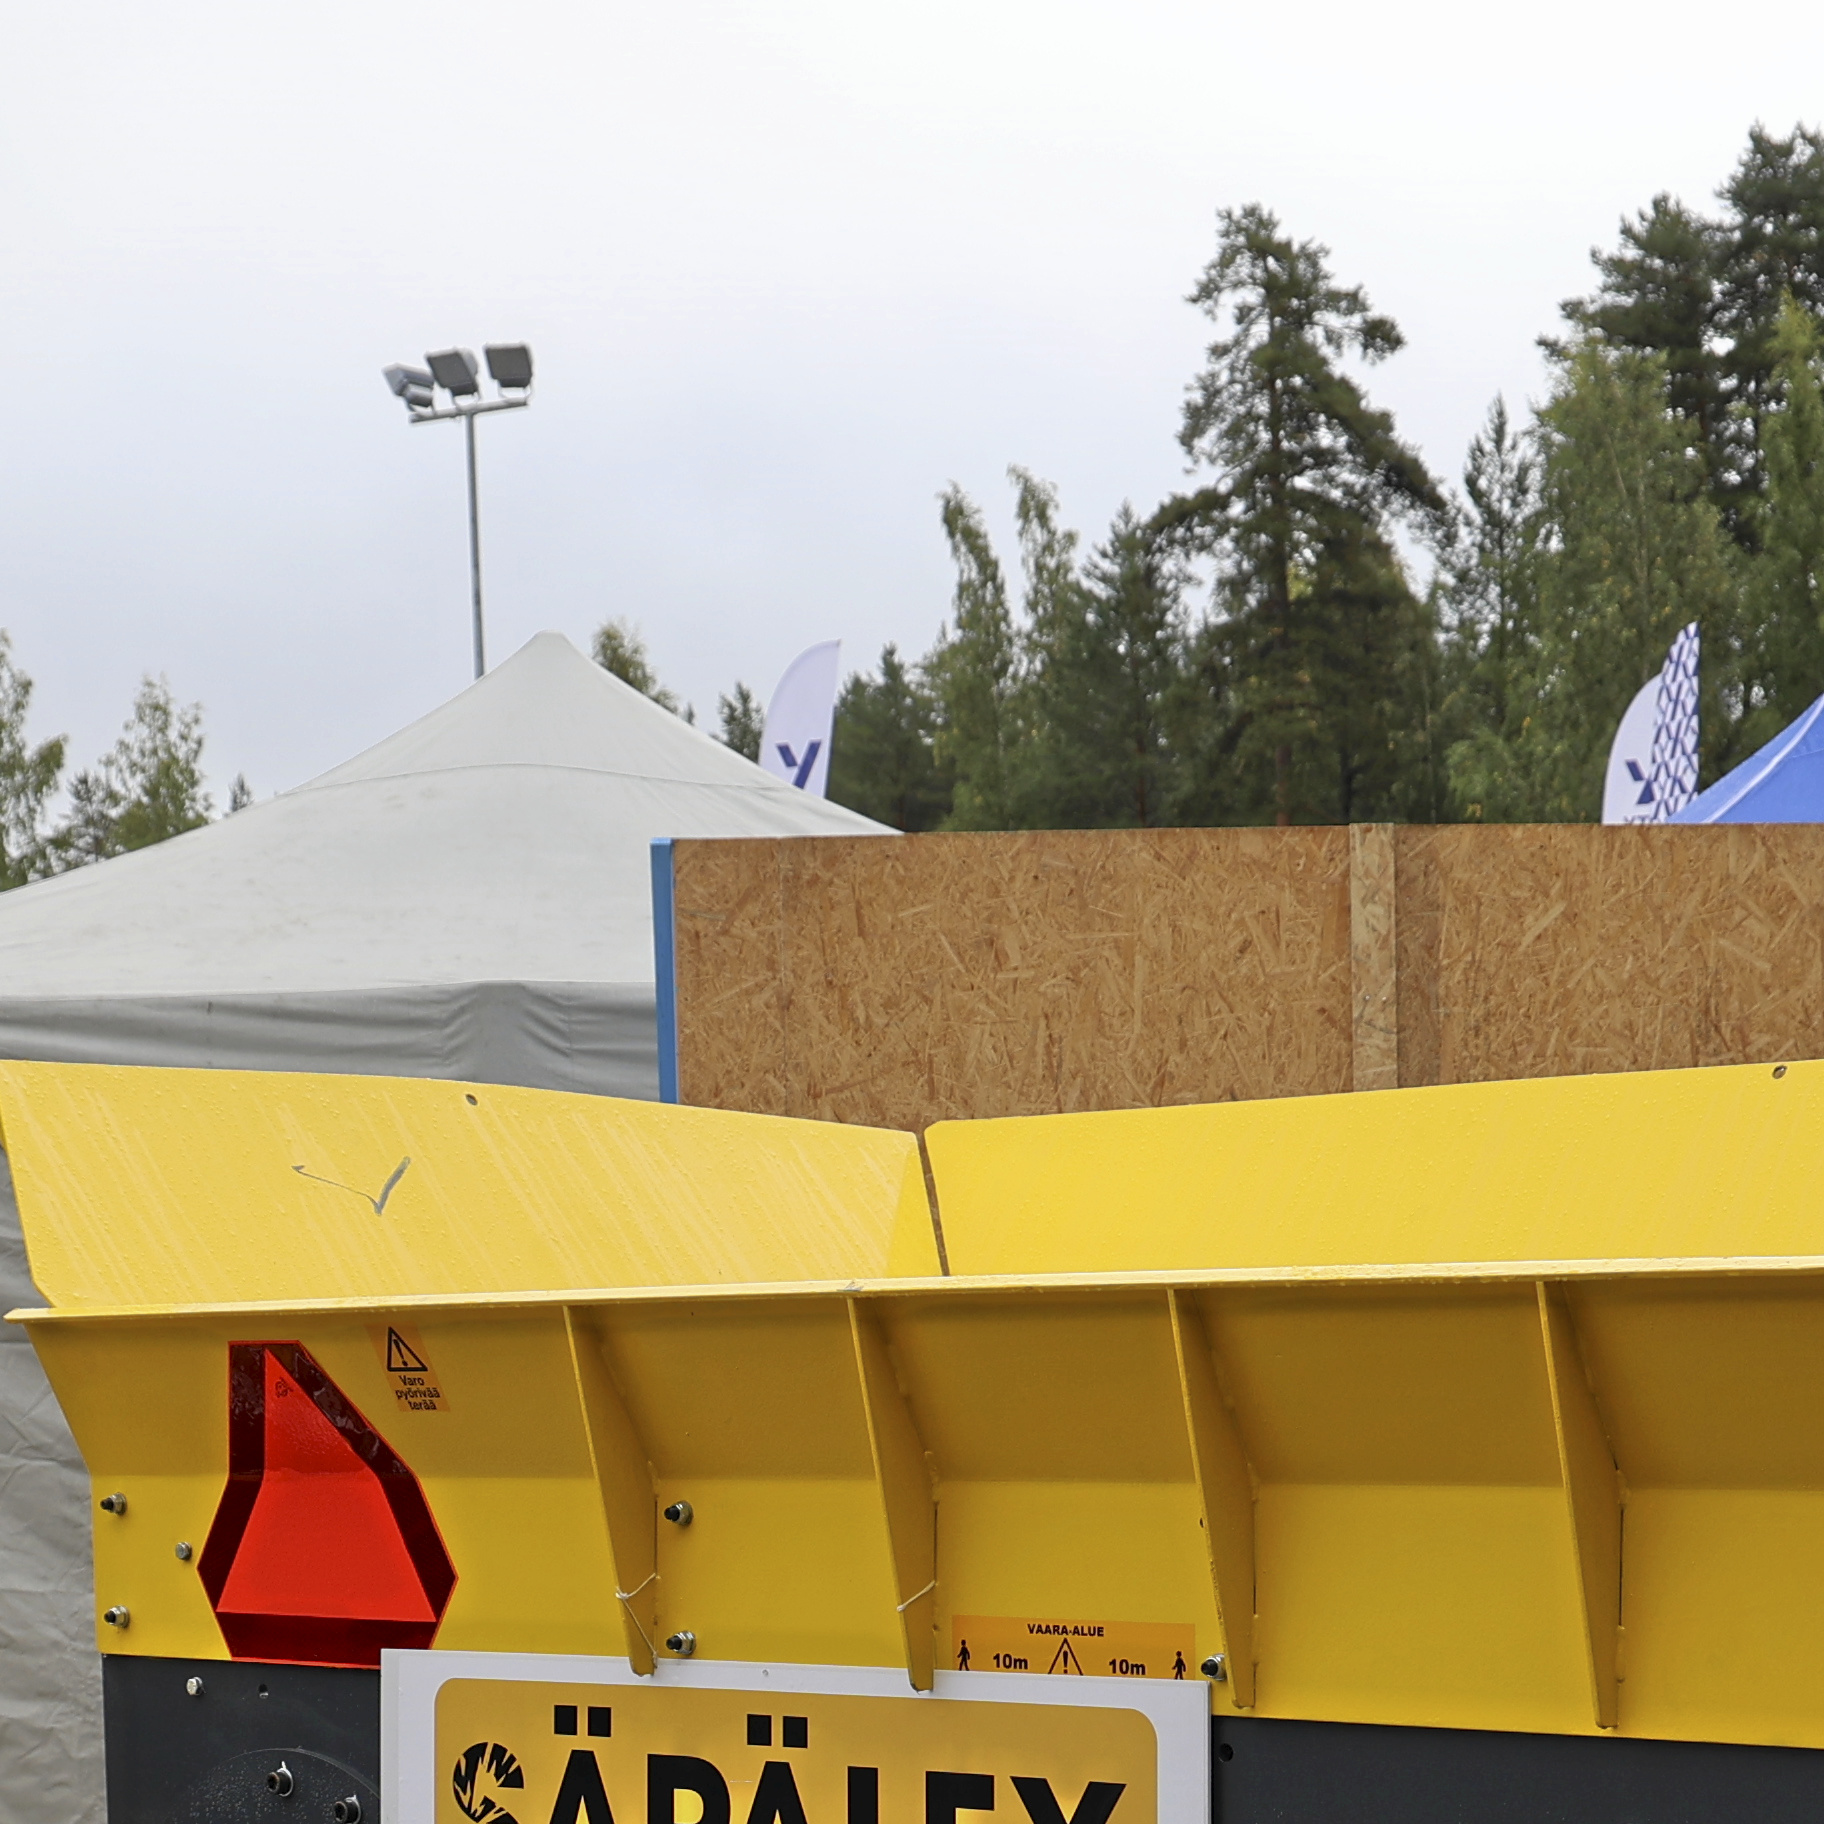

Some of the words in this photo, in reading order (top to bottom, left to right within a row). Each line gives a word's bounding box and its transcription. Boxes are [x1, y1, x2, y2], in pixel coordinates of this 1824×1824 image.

[398, 1375, 425, 1386] Varo
[395, 1387, 441, 1400] pyörivää
[407, 1399, 438, 1410] terää
[1027, 1623, 1105, 1638] VAARA-ALUE
[992, 1653, 1029, 1670] 10m
[1109, 1658, 1147, 1676] 10m
